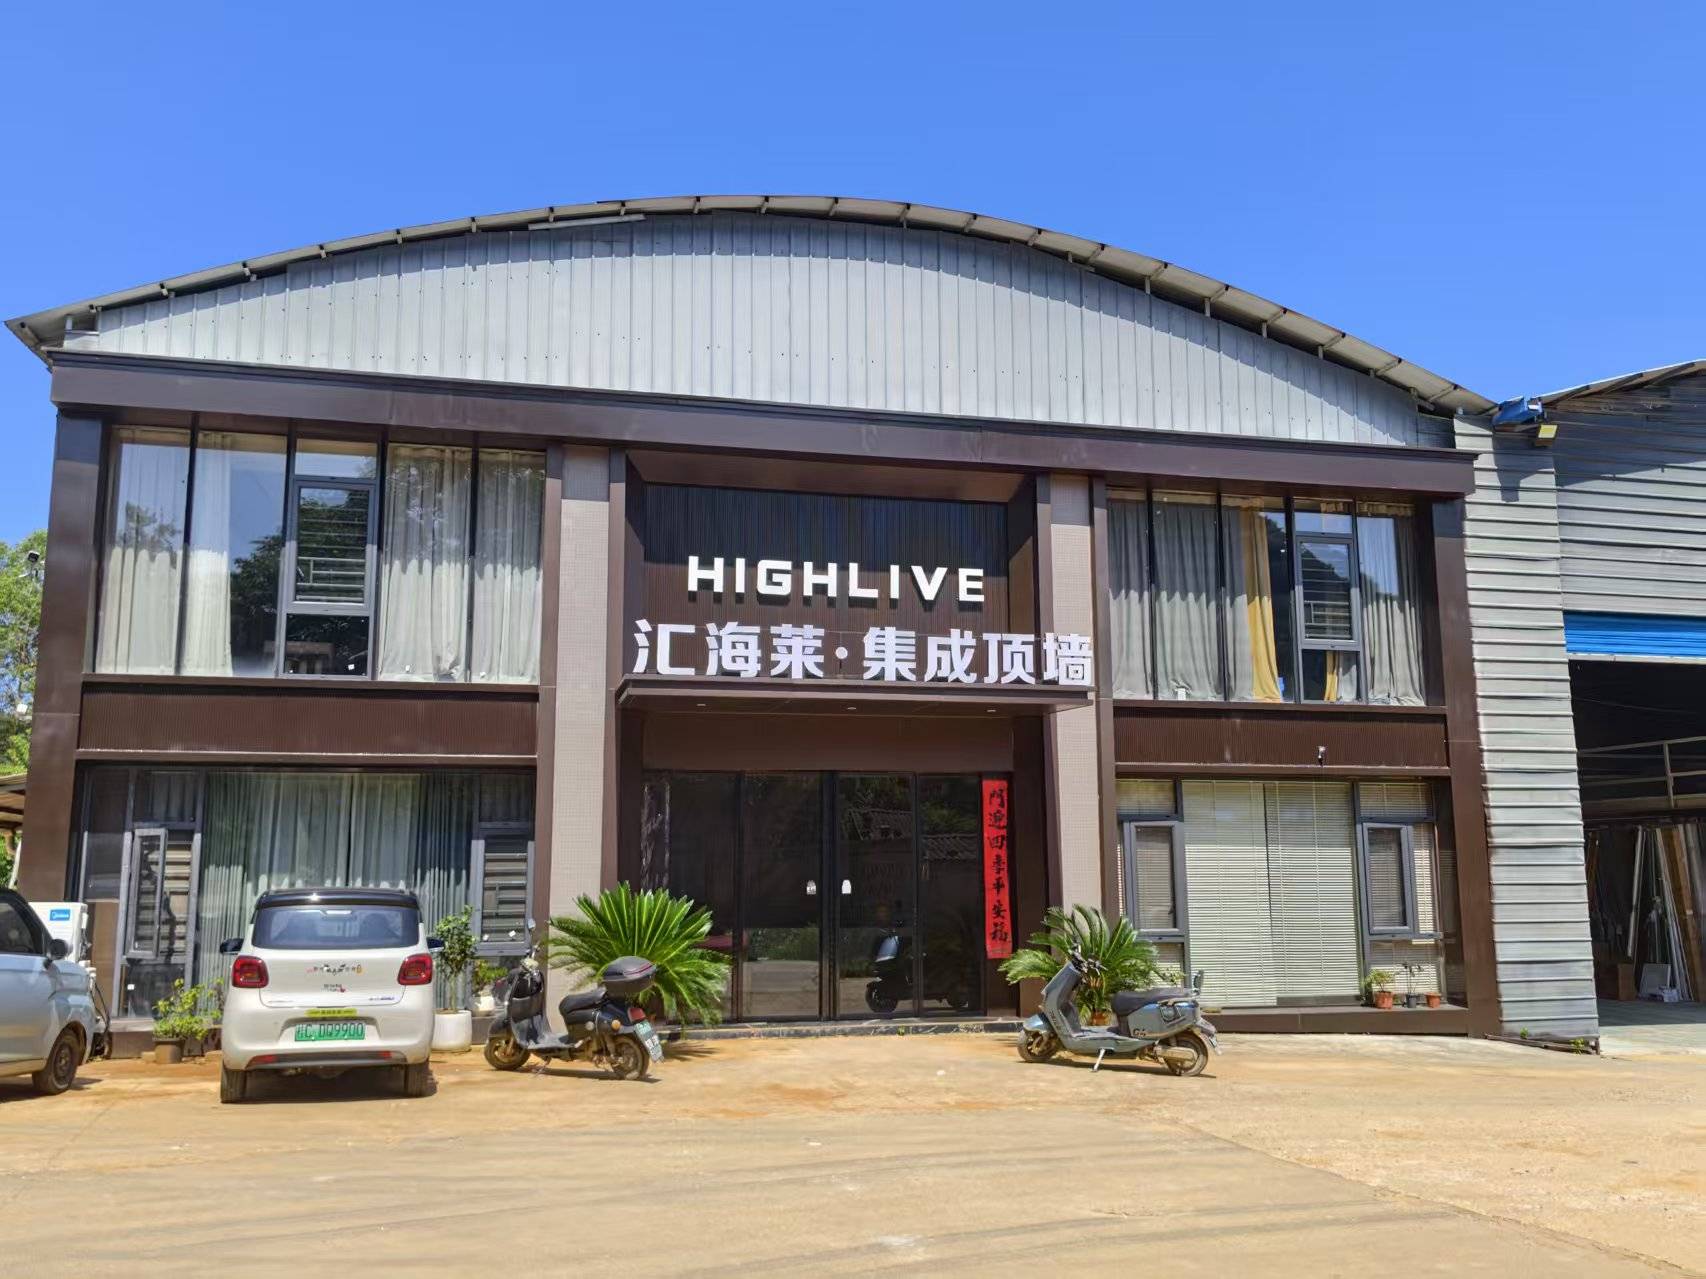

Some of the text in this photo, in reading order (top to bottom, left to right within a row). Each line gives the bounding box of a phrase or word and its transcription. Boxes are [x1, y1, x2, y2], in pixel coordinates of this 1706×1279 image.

[687, 555, 985, 602] HIGHLIVE
[633, 618, 1094, 686] 汇海莱·集成顶墙
